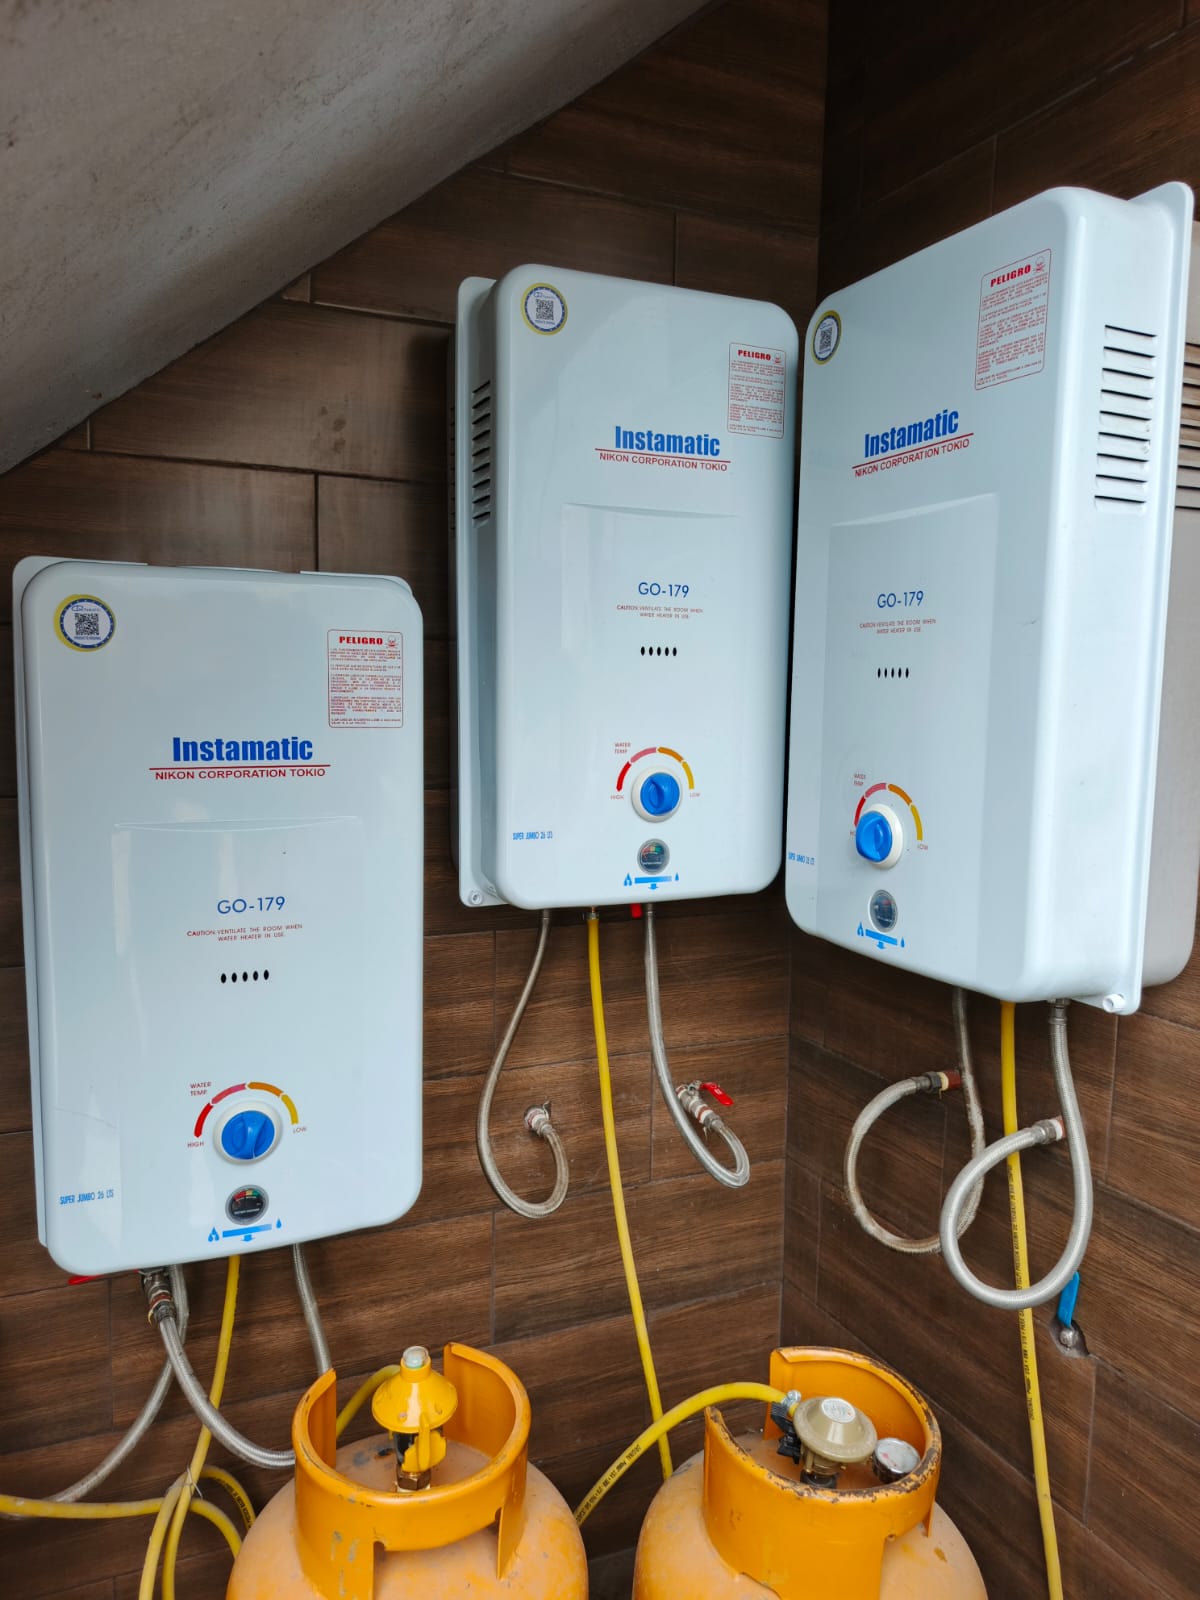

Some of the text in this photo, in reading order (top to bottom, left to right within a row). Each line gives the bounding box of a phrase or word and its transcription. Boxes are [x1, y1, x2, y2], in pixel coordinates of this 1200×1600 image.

[990, 264, 1031, 288] PELIGRO
[737, 349, 771, 361] PELIGRO
[615, 425, 720, 457] Instamatic
[864, 409, 959, 458] Instamatic
[599, 452, 728, 472] NIKON CORPORATION TOKIO
[854, 438, 970, 478] NIKON CORPORATION TOKIO
[638, 582, 689, 598] GO-179
[877, 590, 924, 608] GO-179
[338, 636, 383, 646] PELIGRO
[172, 736, 313, 762] Instamatic
[155, 768, 326, 780] NIKON CORPORATION TOKIO
[217, 896, 285, 914] GO-179
